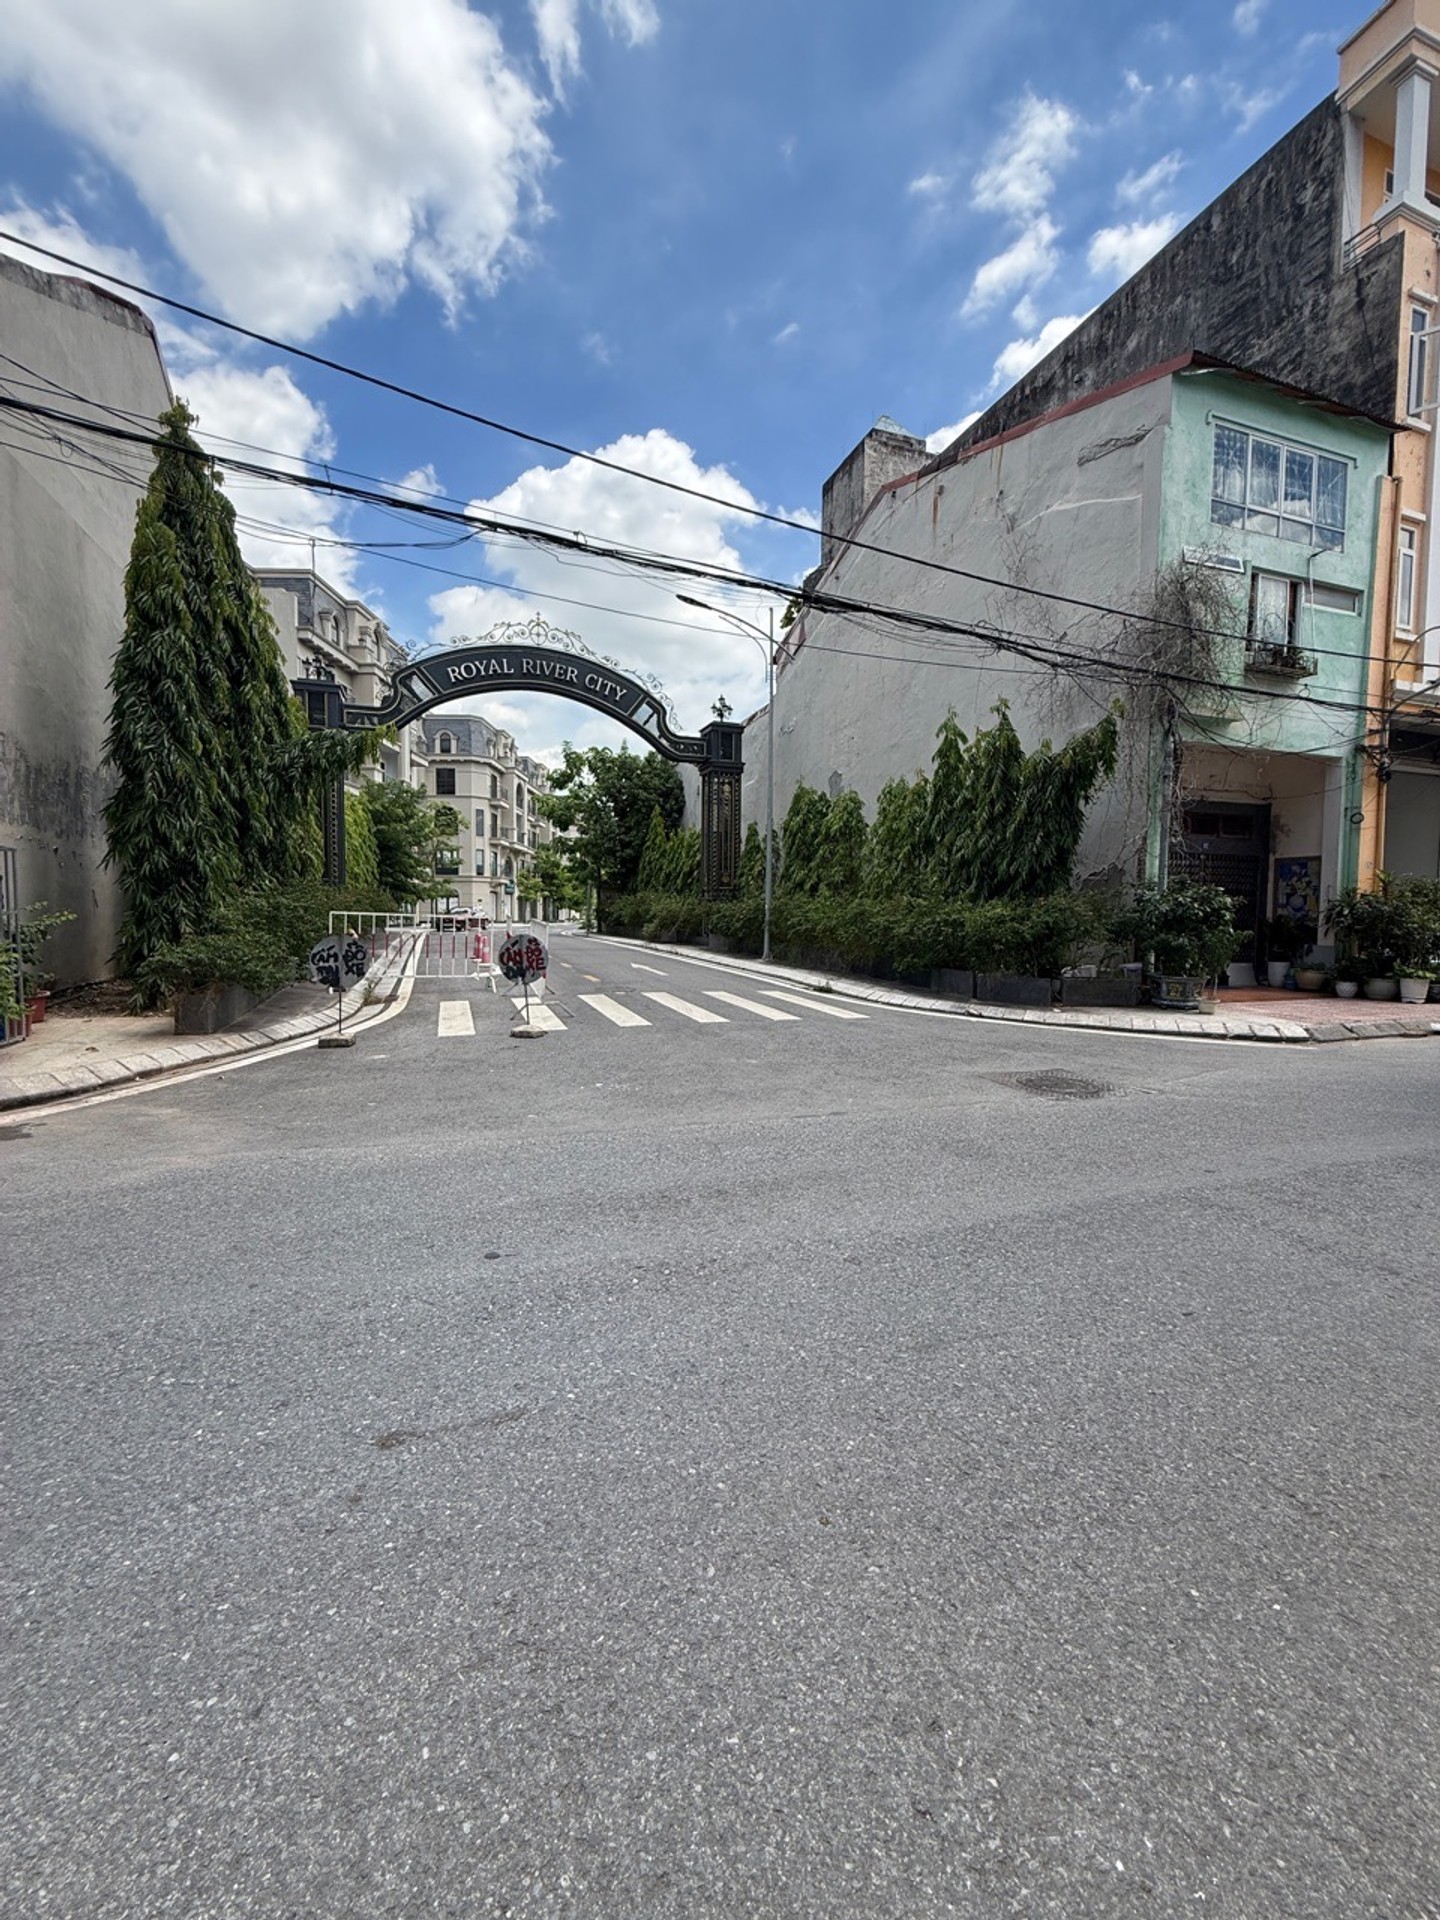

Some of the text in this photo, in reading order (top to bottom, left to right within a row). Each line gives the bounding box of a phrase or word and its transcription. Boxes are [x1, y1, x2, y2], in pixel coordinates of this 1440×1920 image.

[447, 658, 627, 701] ROYAL RIVER CITY
